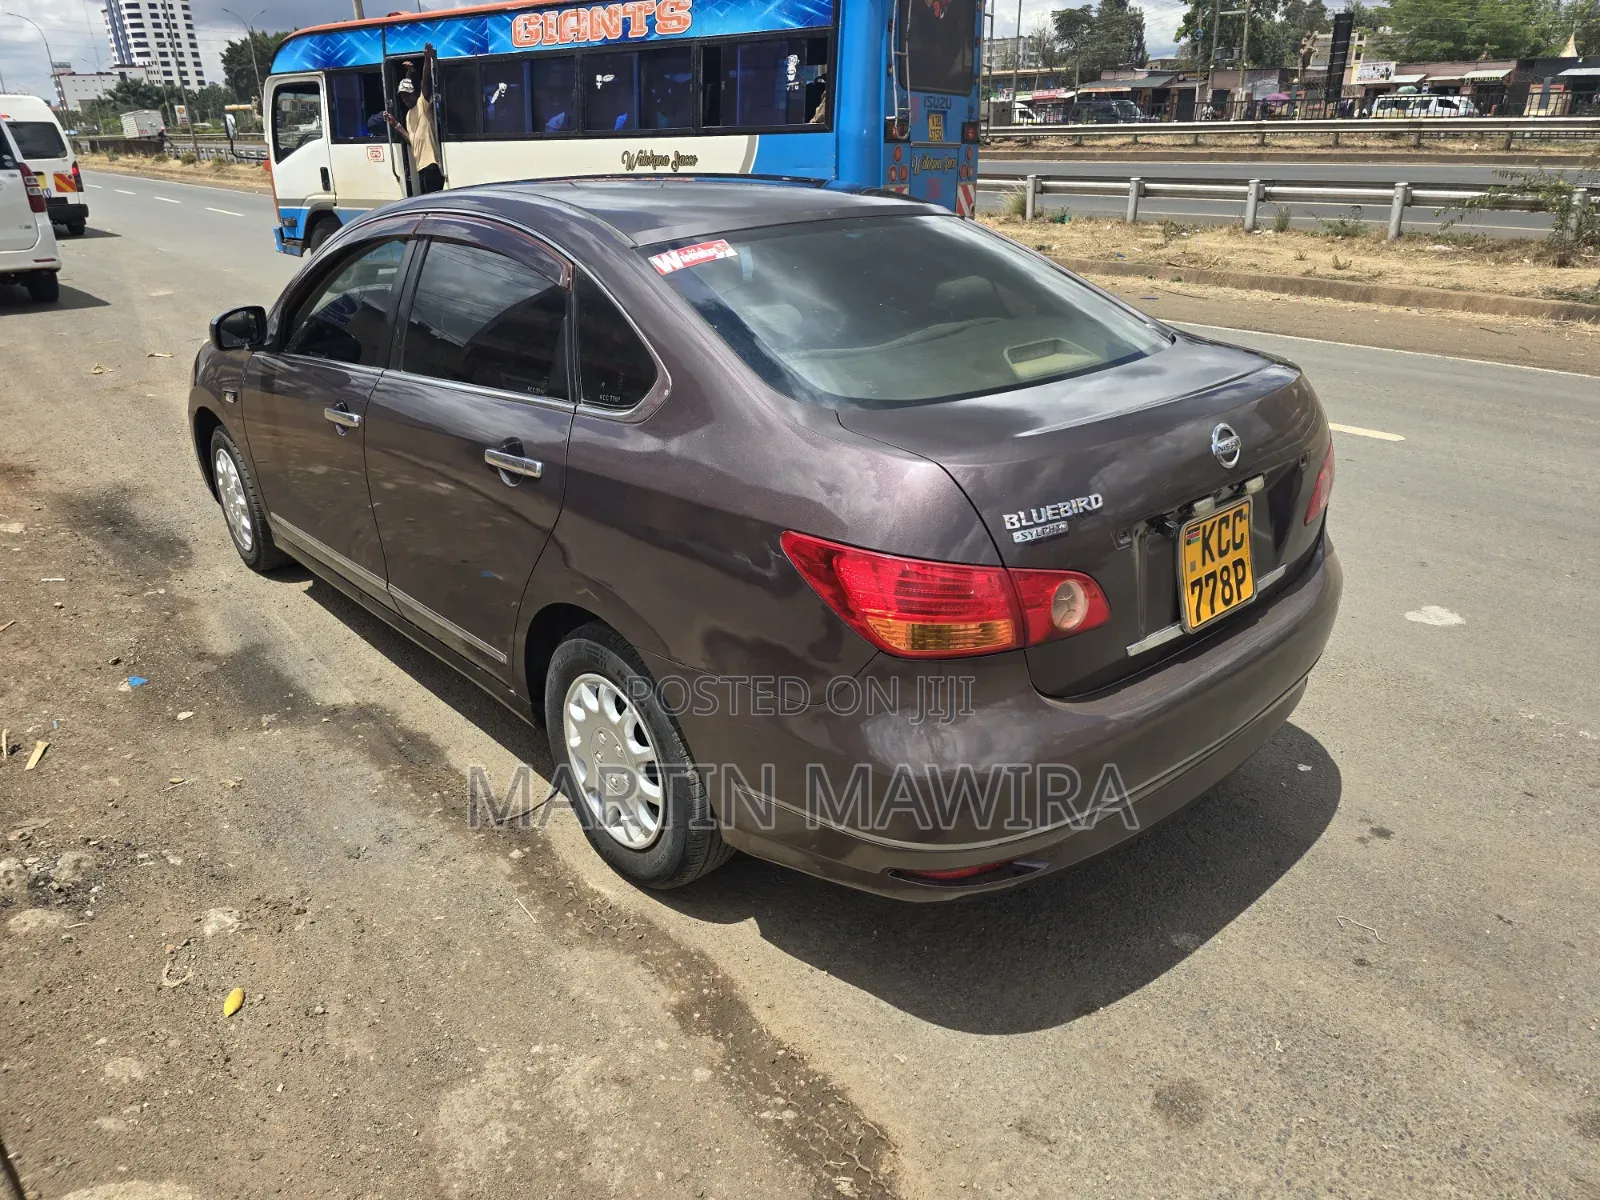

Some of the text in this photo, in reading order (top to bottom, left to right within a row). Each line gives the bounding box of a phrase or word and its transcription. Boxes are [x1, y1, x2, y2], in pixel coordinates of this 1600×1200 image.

[512, 0, 692, 47] GIANTS
[924, 96, 952, 109] ISUZU
[1002, 493, 1104, 530] BLUEBIRD
[1202, 508, 1245, 567] KCC
[1190, 558, 1246, 622] 778P
